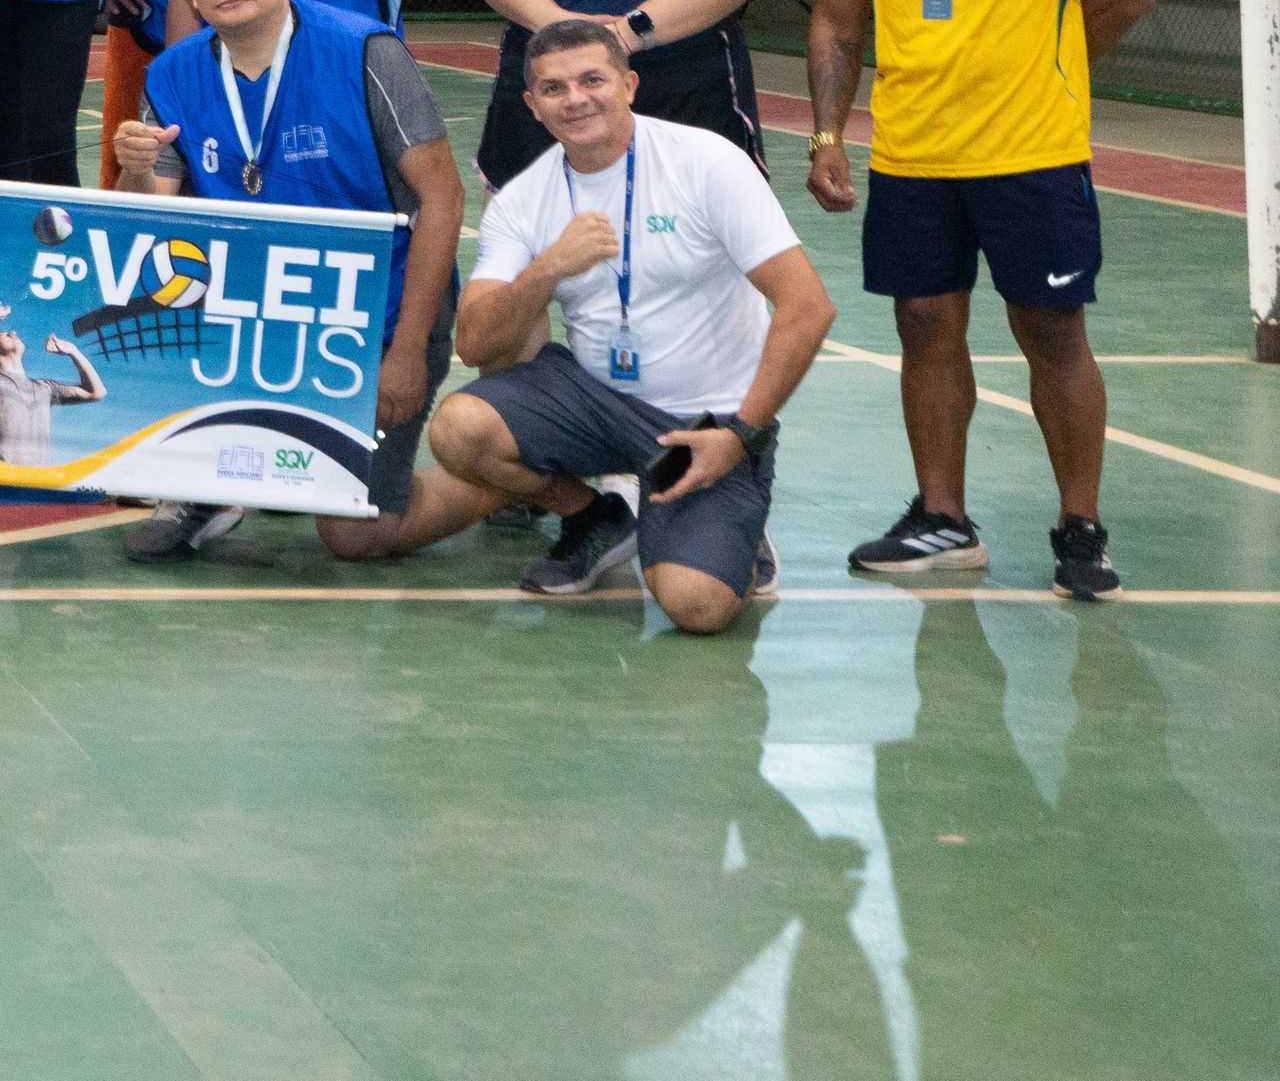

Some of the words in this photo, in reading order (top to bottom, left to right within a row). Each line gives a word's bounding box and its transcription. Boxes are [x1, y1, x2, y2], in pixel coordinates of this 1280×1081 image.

[202, 137, 220, 173] 6
[88, 228, 375, 328] VOLEI
[192, 314, 366, 398] JUS
[275, 448, 315, 469] SQV
